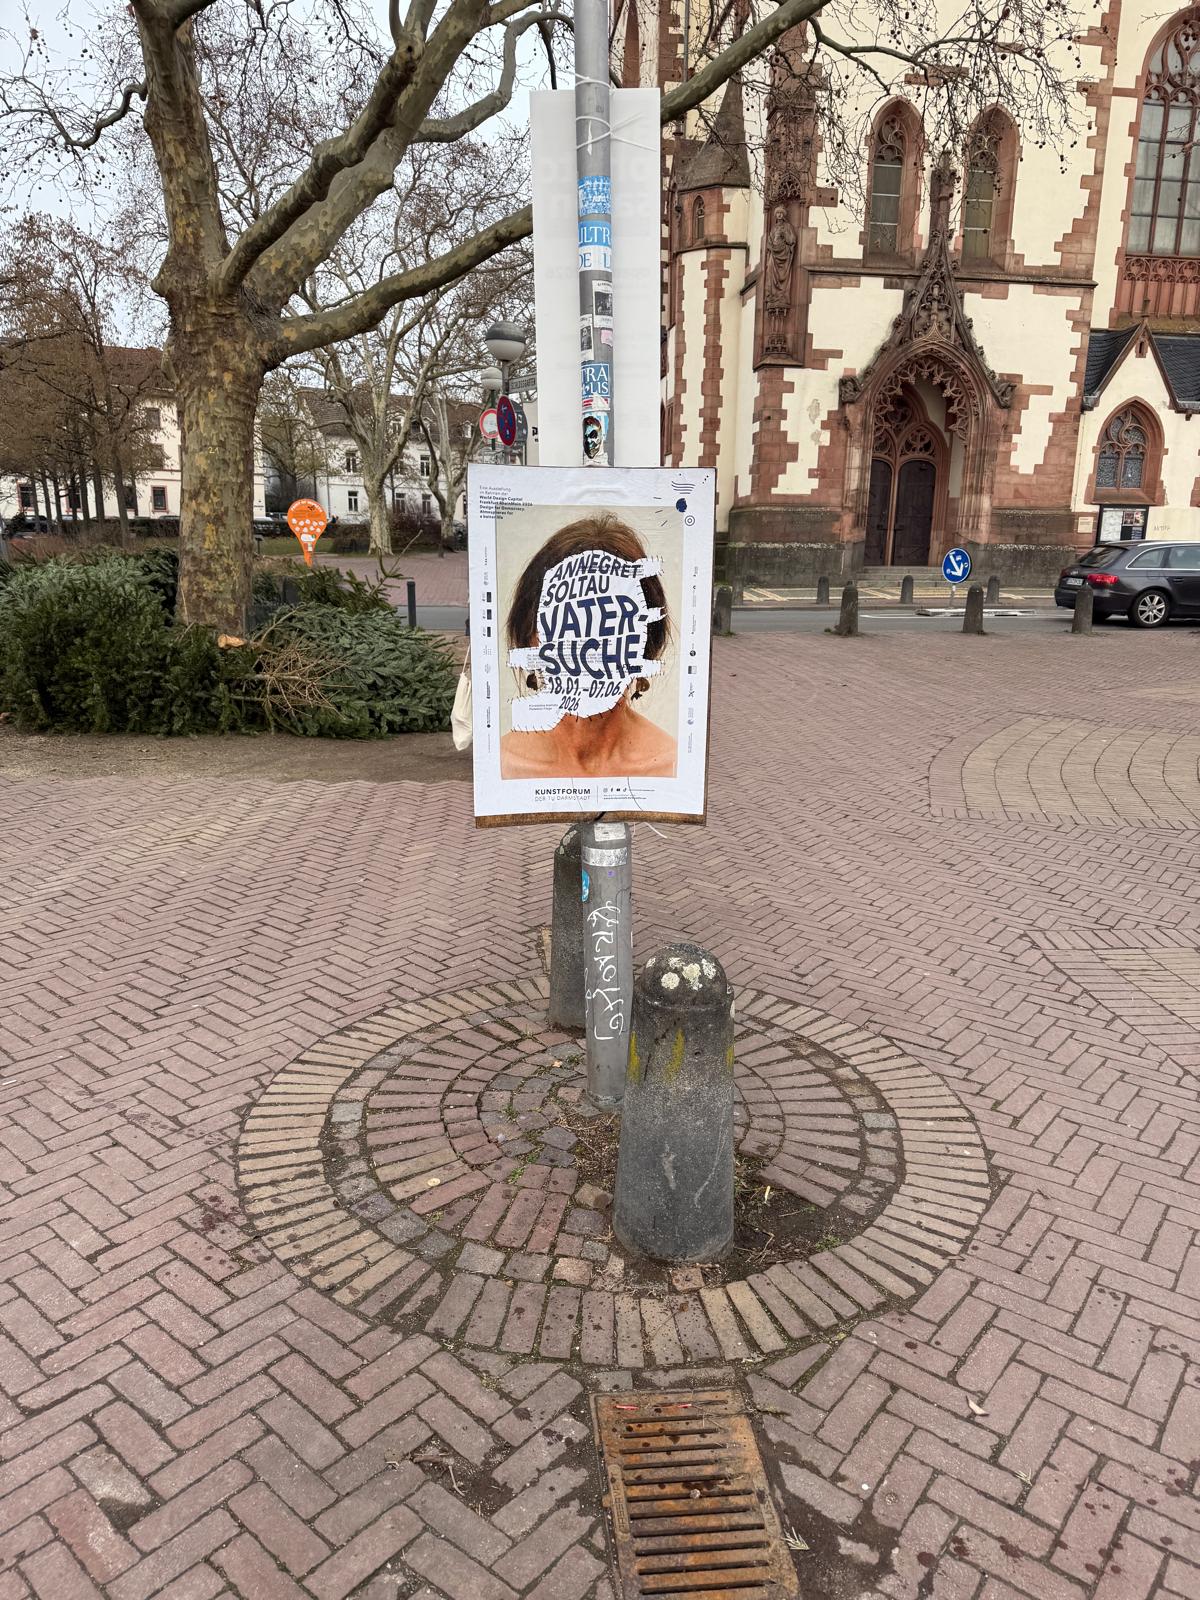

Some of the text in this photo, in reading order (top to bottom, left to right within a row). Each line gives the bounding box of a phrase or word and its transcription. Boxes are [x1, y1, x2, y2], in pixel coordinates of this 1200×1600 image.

[549, 554, 641, 583] ANNEGRET
[543, 575, 610, 607] SOLTAU
[540, 595, 648, 642] VATER-
[539, 634, 641, 679] SUCHE
[559, 696, 580, 711] 2026
